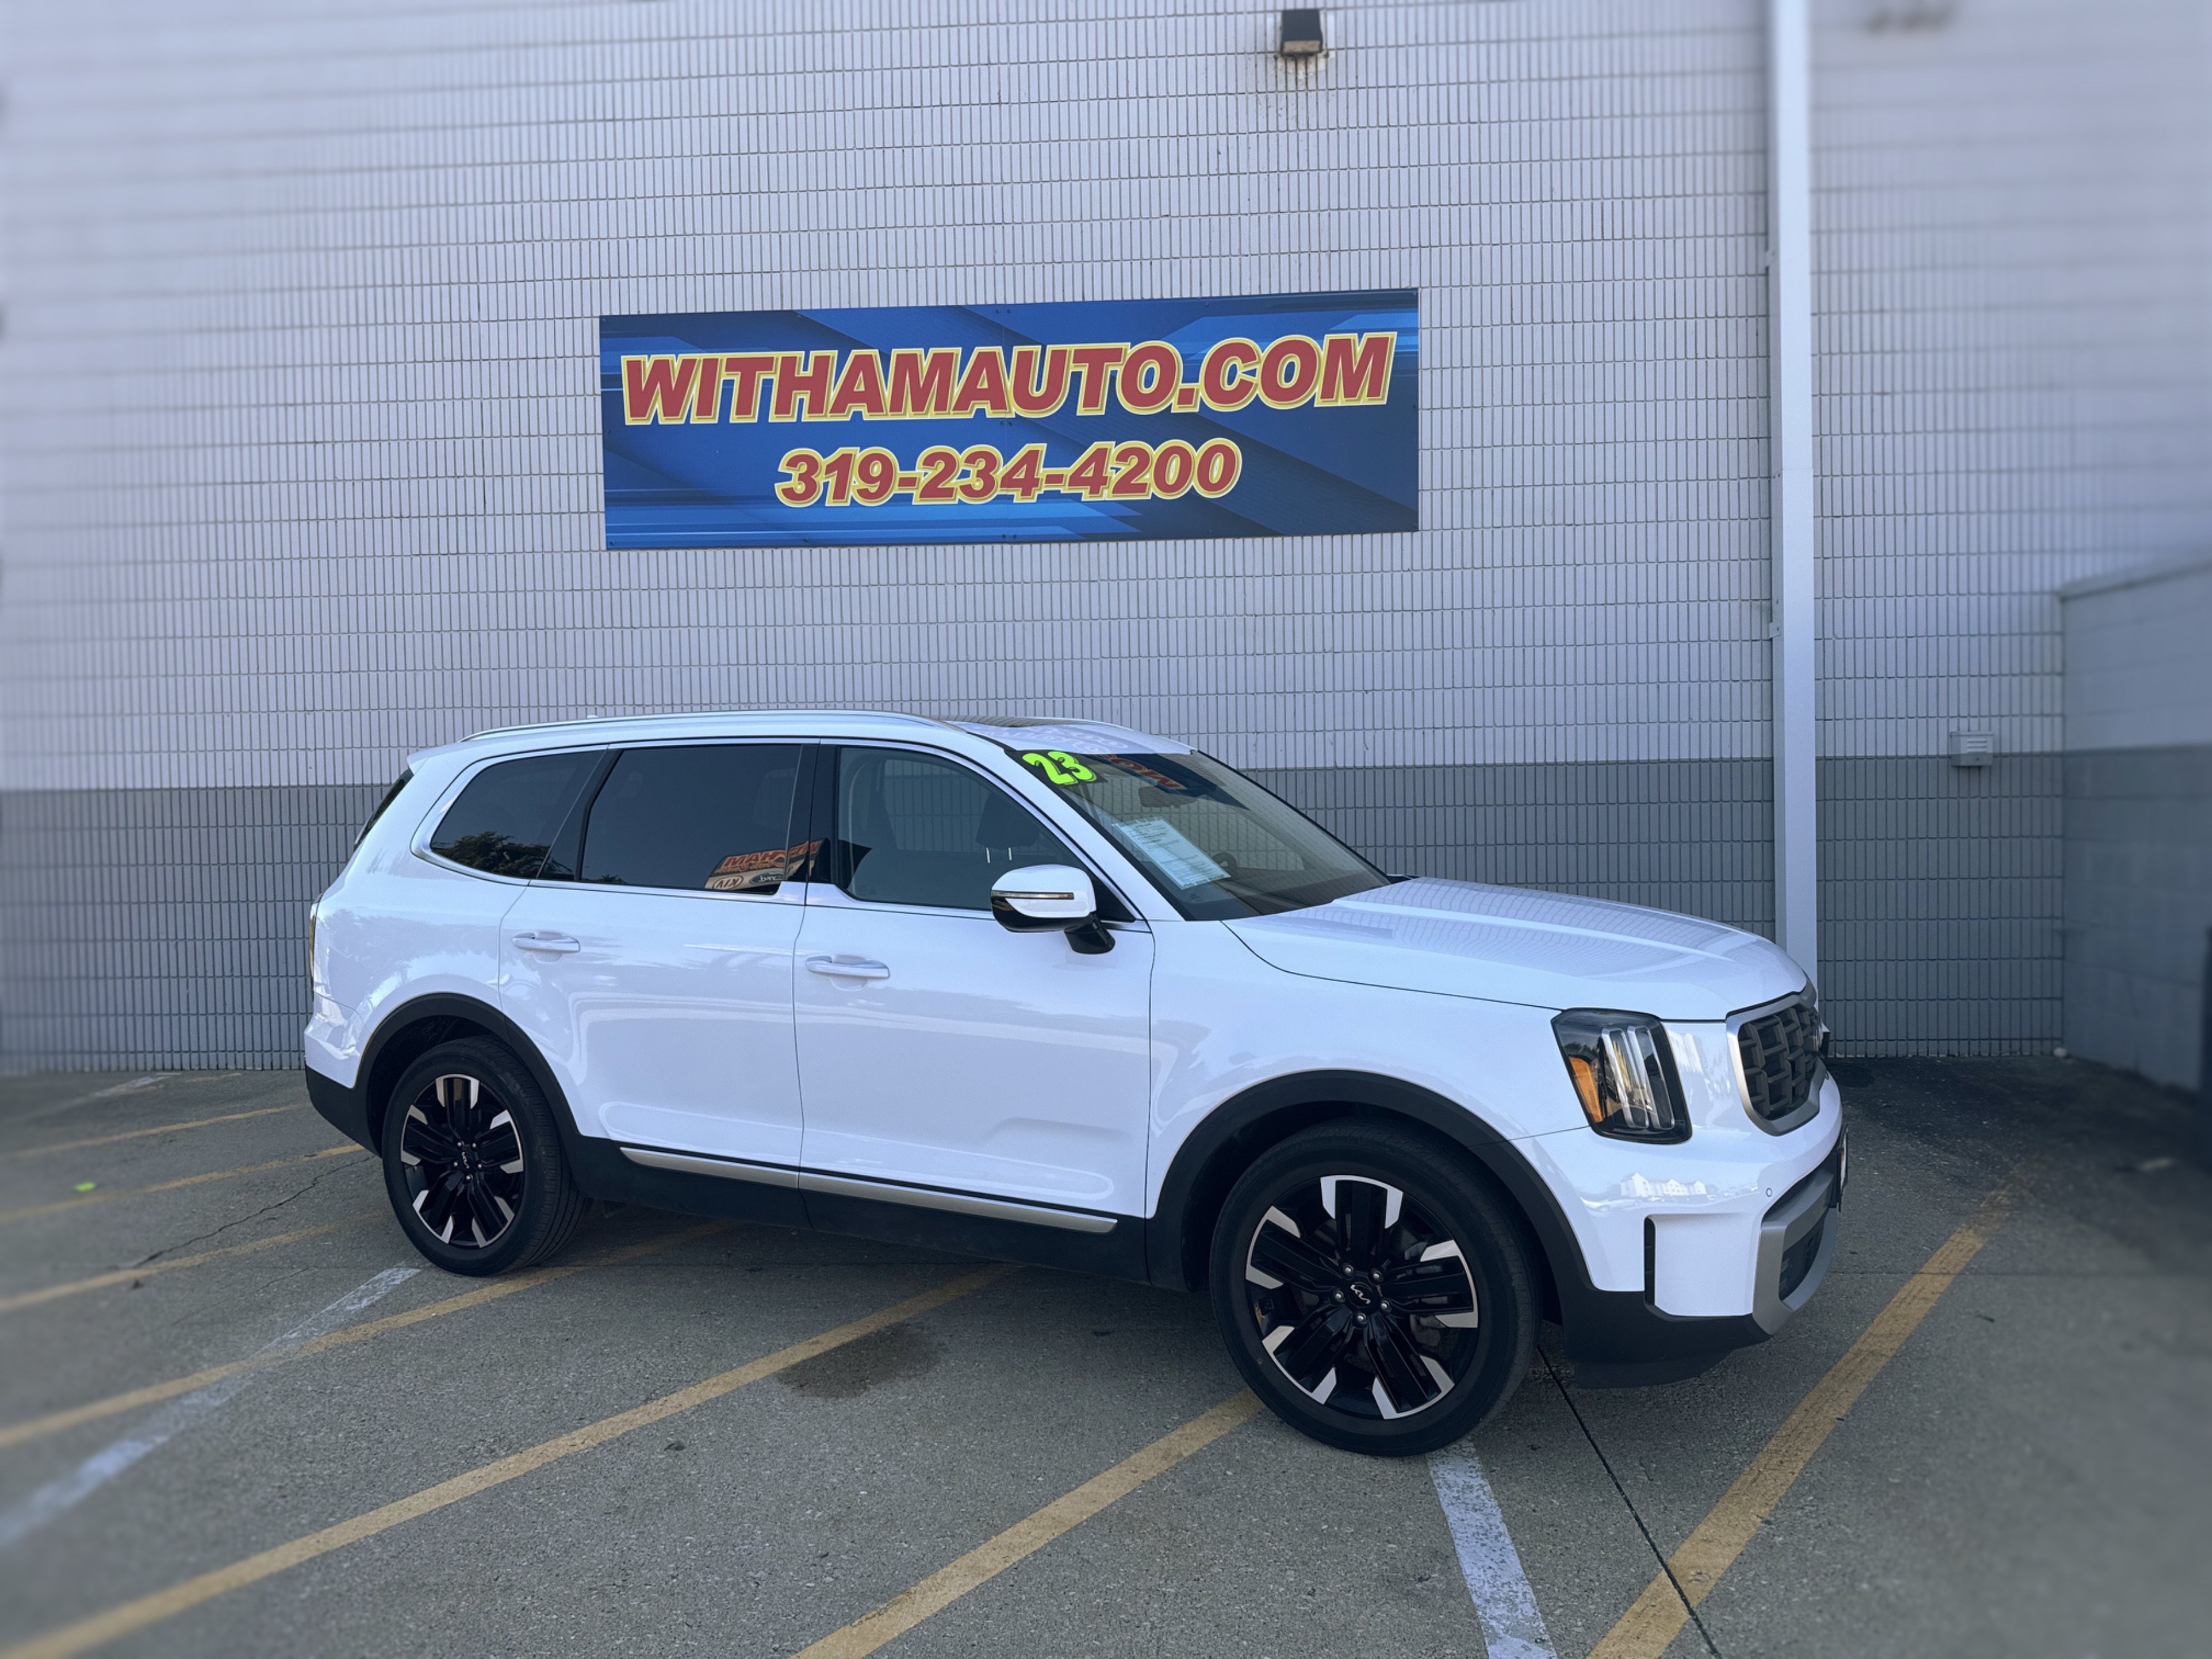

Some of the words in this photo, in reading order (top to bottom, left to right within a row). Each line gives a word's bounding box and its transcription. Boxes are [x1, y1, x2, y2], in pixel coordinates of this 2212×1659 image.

[620, 331, 1398, 425] WITHAMAUTO.COM
[776, 437, 1243, 507] 319-234-4200
[1022, 751, 1097, 785] 23
